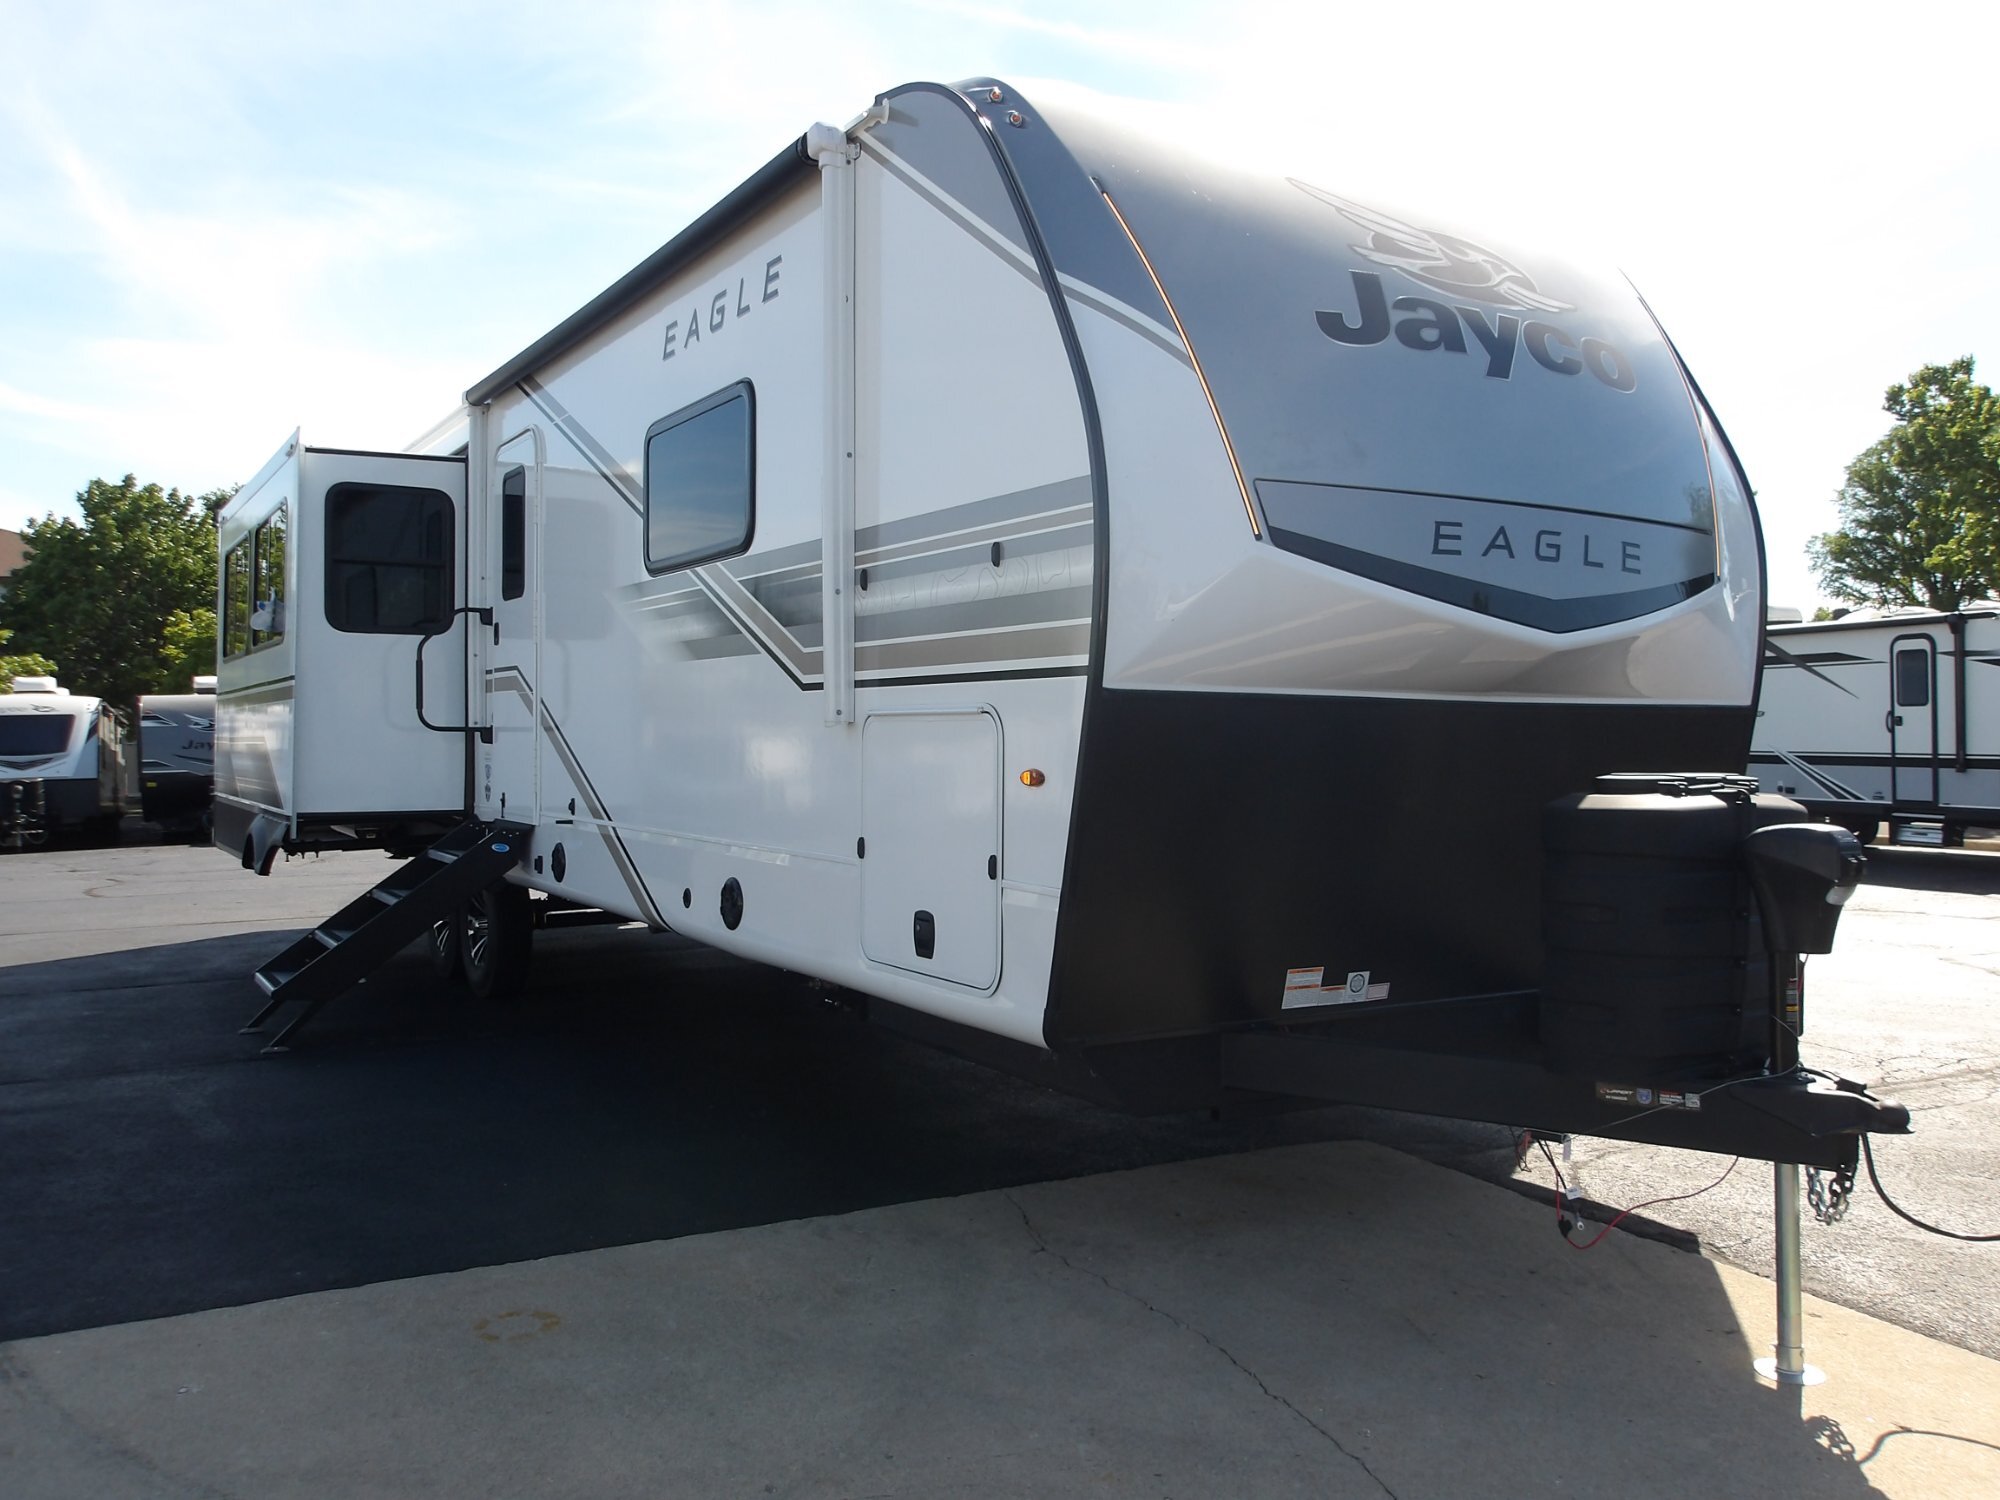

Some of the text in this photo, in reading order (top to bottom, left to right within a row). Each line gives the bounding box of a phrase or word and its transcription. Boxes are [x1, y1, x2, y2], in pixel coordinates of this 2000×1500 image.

[662, 254, 782, 361] EAGLE
[1313, 268, 1637, 393] Jayco
[1431, 520, 1641, 575] EAGLE
